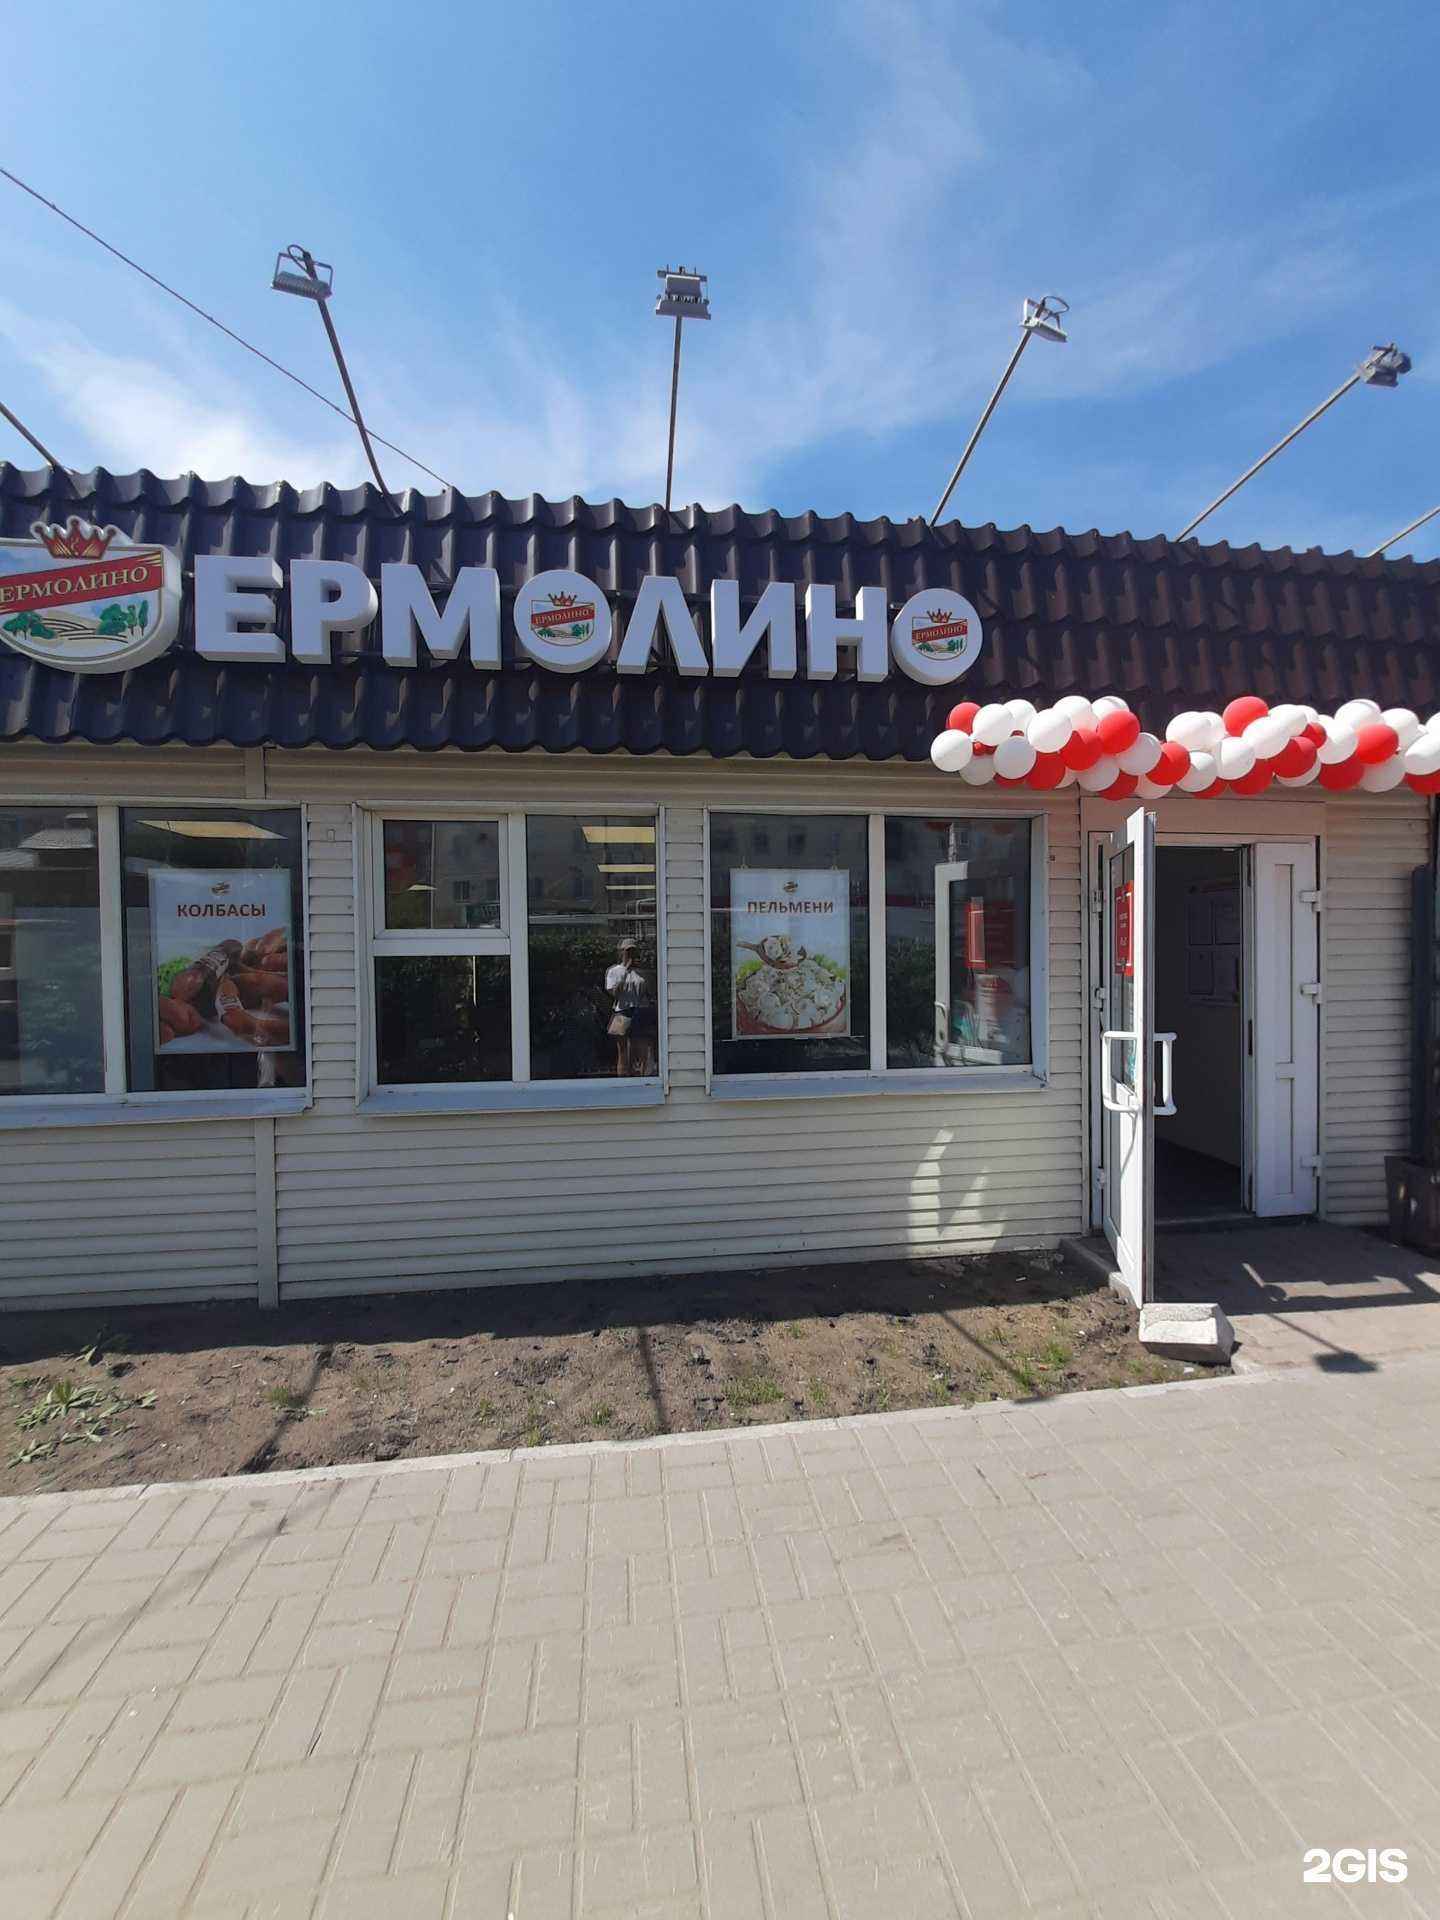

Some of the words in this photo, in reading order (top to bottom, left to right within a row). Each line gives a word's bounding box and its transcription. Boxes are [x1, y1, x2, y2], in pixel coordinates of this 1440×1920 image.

[0, 566, 148, 603] ЕРМОЛИНО
[194, 554, 982, 686] ЕРМОЛИНО
[177, 903, 266, 917] КОЛБАСЫ
[747, 900, 834, 914] ПЕЛЬМЕНИ
